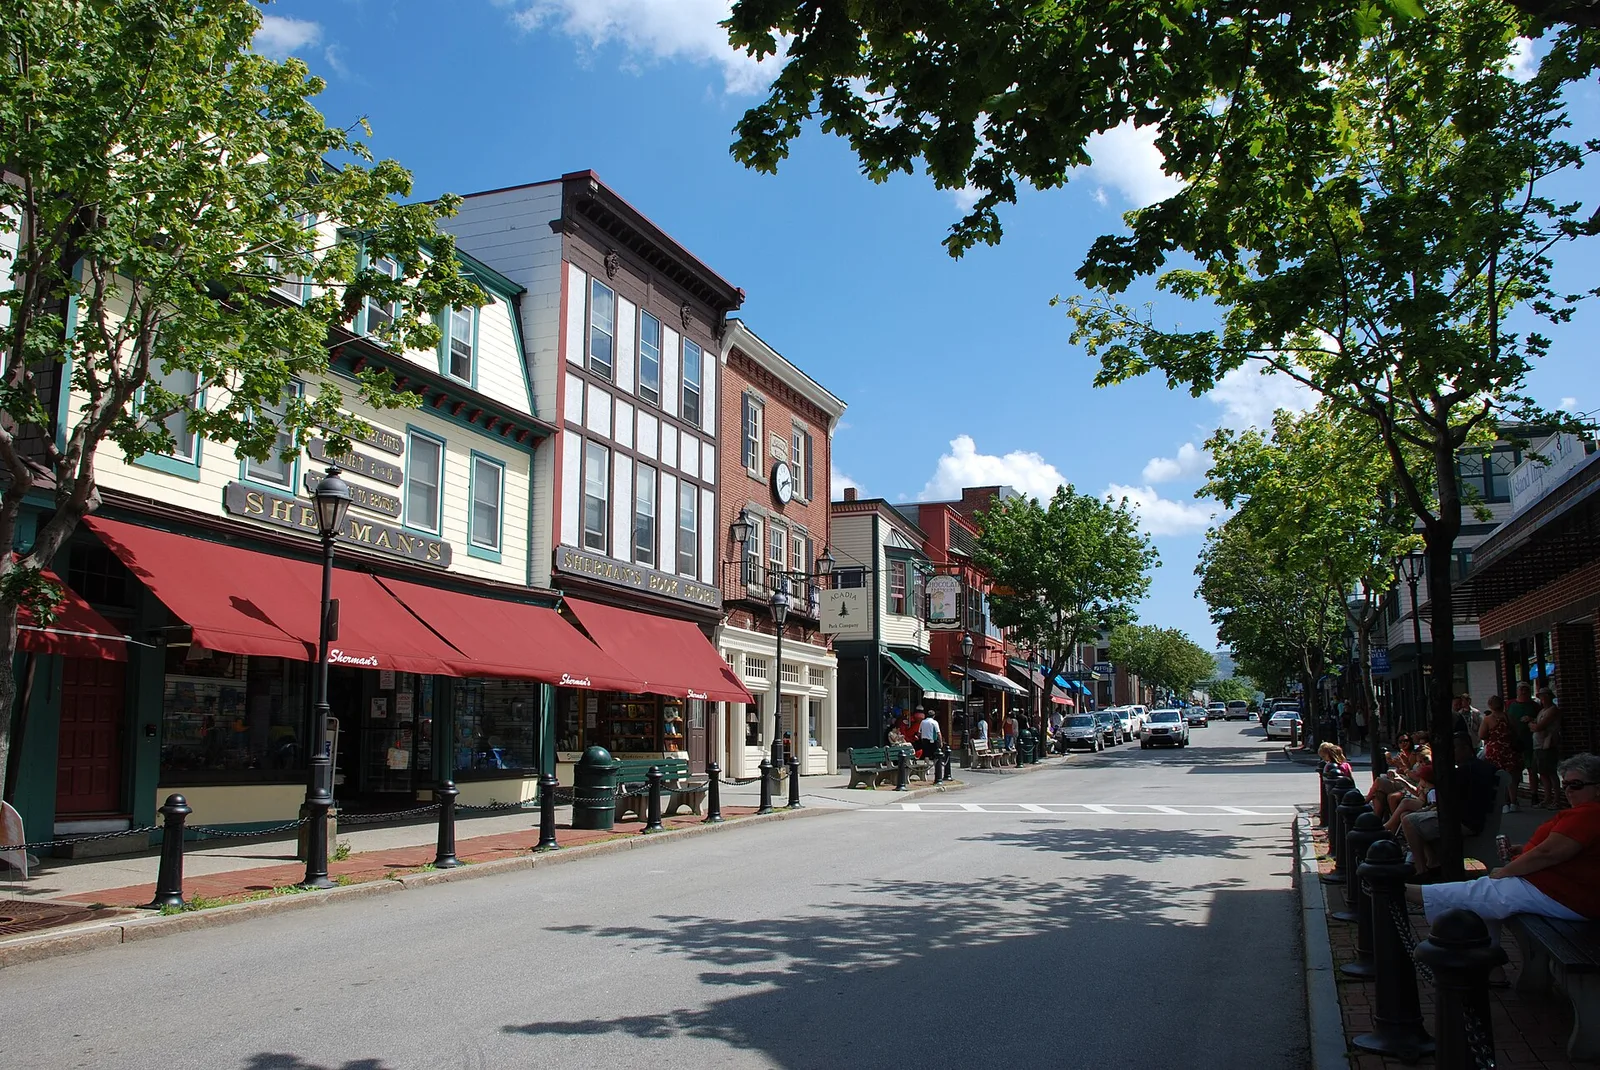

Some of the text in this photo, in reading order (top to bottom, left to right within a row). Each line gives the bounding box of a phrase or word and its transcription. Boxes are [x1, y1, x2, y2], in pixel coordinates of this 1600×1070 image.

[358, 489, 367, 504] TO
[244, 491, 442, 561] SHEMAN'S
[563, 552, 716, 604] SHERMAN'S BOOK STORE
[830, 591, 857, 602] ACADIA
[838, 622, 859, 630] Company
[328, 649, 379, 667] Sherman's
[559, 673, 592, 687] Sherman's
[686, 689, 708, 700] Sherman's
